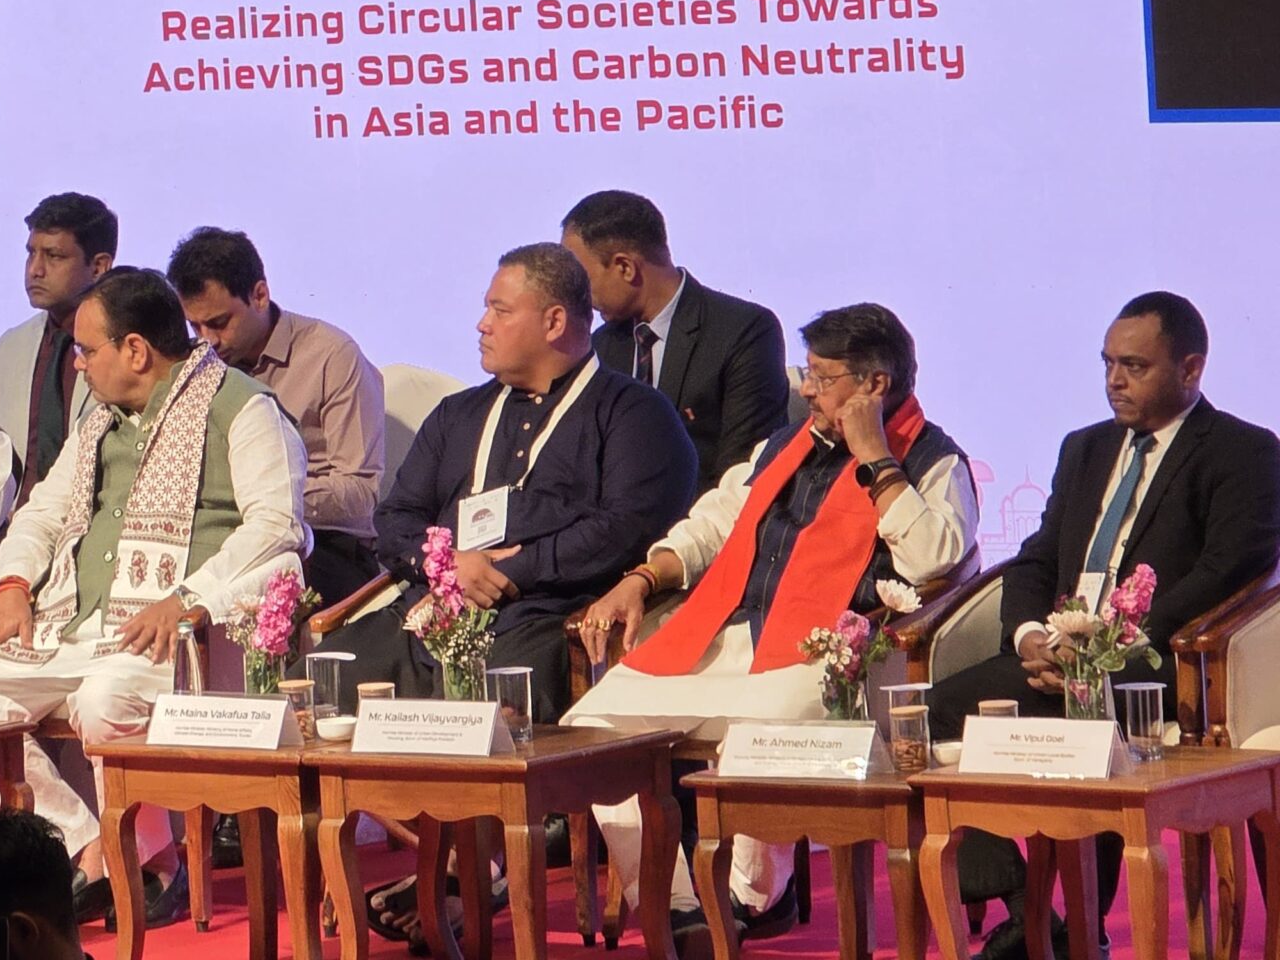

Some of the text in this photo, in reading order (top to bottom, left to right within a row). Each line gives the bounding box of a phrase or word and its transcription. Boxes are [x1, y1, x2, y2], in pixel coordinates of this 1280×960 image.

[160, 4, 344, 42] Realizing
[142, 36, 965, 93] Achieving SDGs and Carbon Neutrality
[313, 94, 784, 139] in Asia and the Pacific
[180, 709, 208, 718] Maina
[251, 711, 271, 720] Talia
[384, 712, 420, 722] Kailash
[752, 737, 842, 749] Mr. Ahmed Nizam
